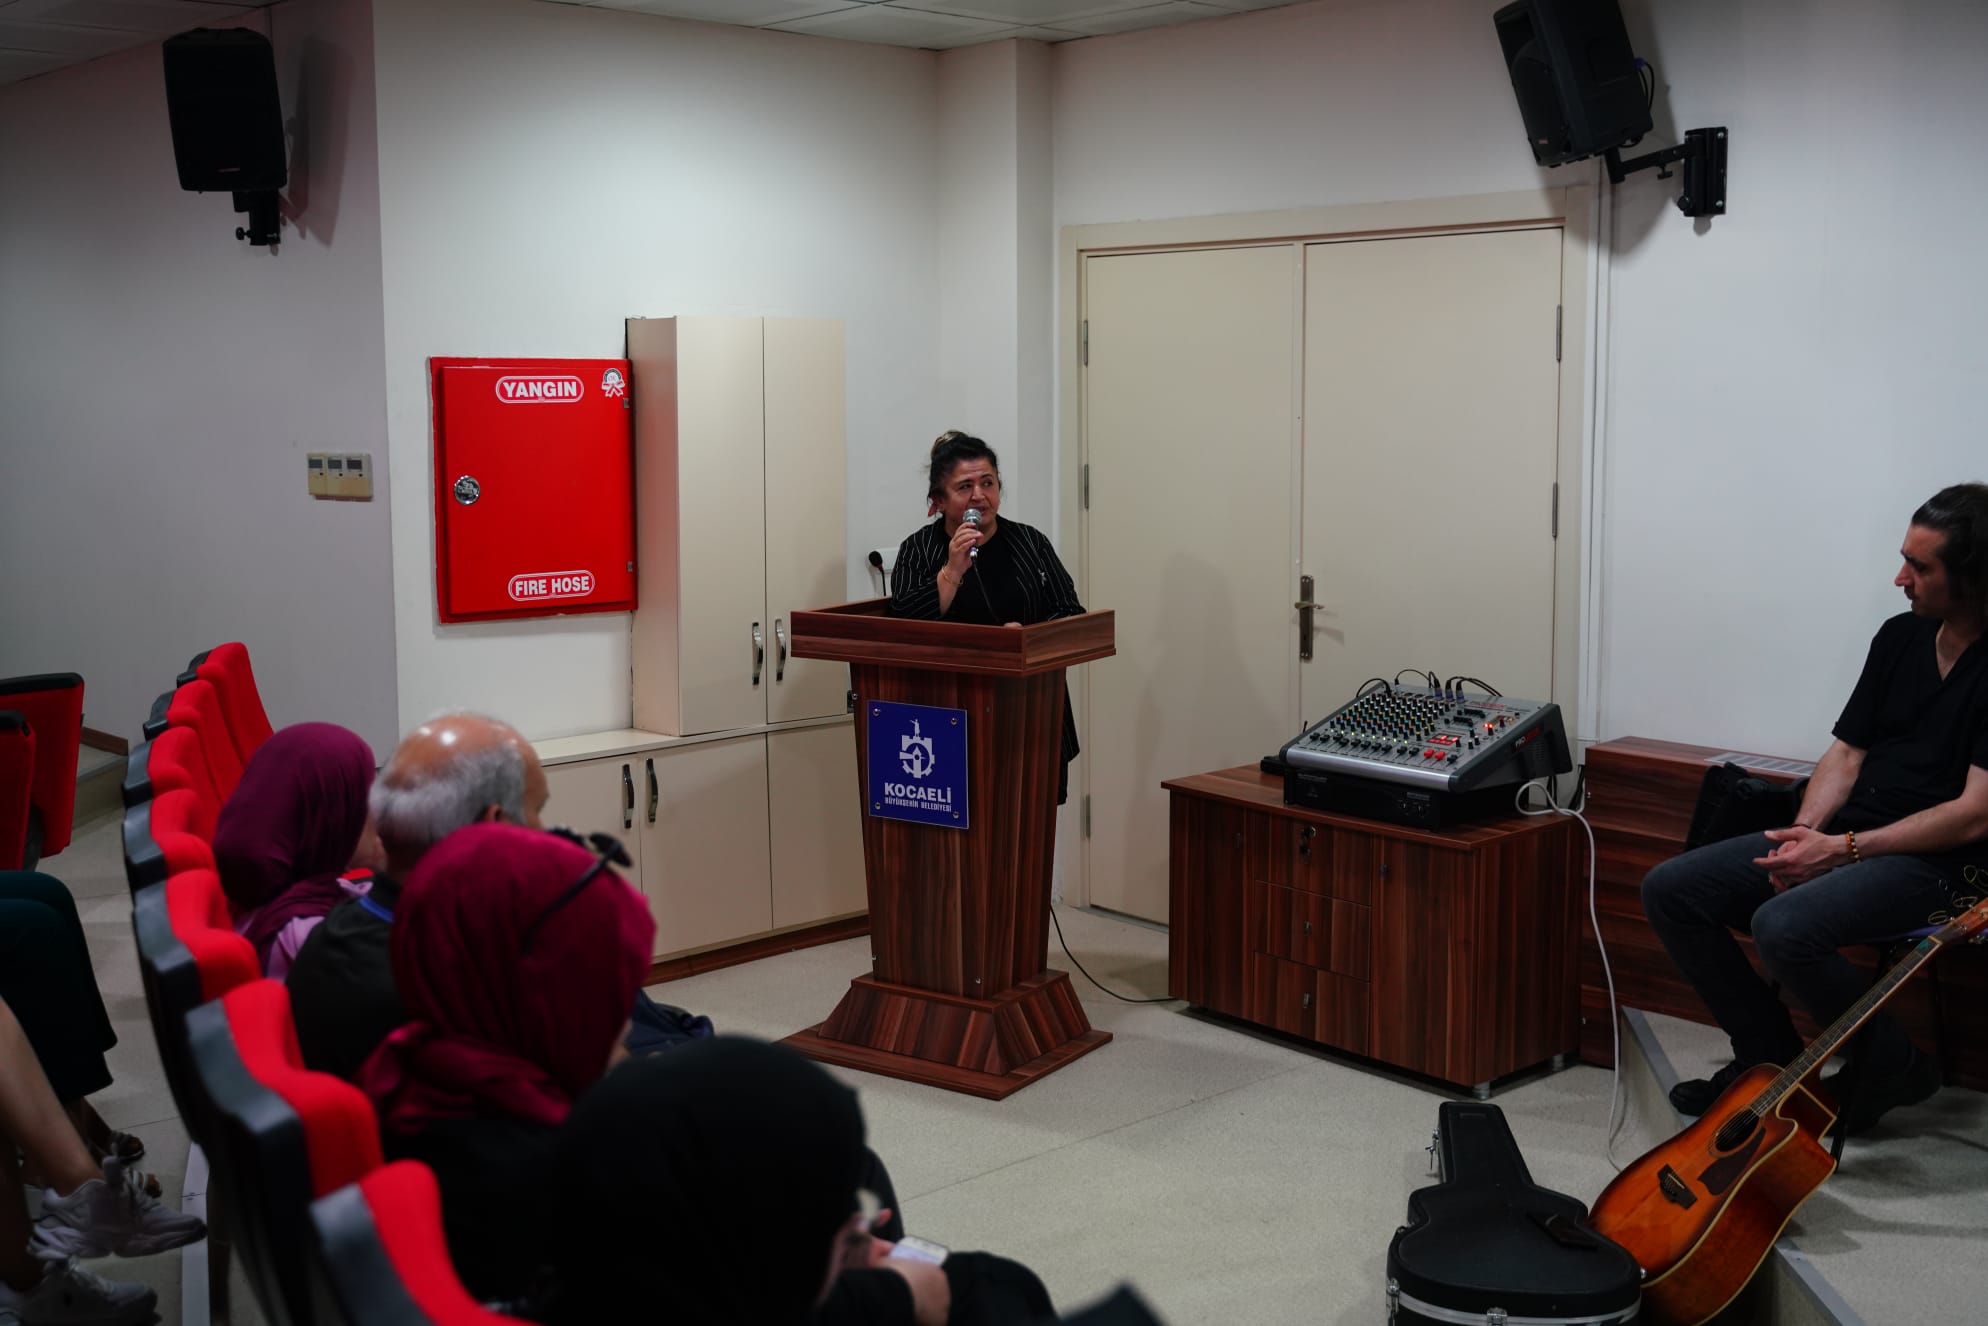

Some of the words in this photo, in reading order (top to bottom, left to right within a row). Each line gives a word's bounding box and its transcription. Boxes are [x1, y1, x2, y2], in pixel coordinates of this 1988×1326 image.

[502, 381, 577, 398] YANGIN
[515, 579, 548, 596] FIRE
[551, 576, 590, 593] HOSE
[884, 782, 952, 803] KOCAELİ
